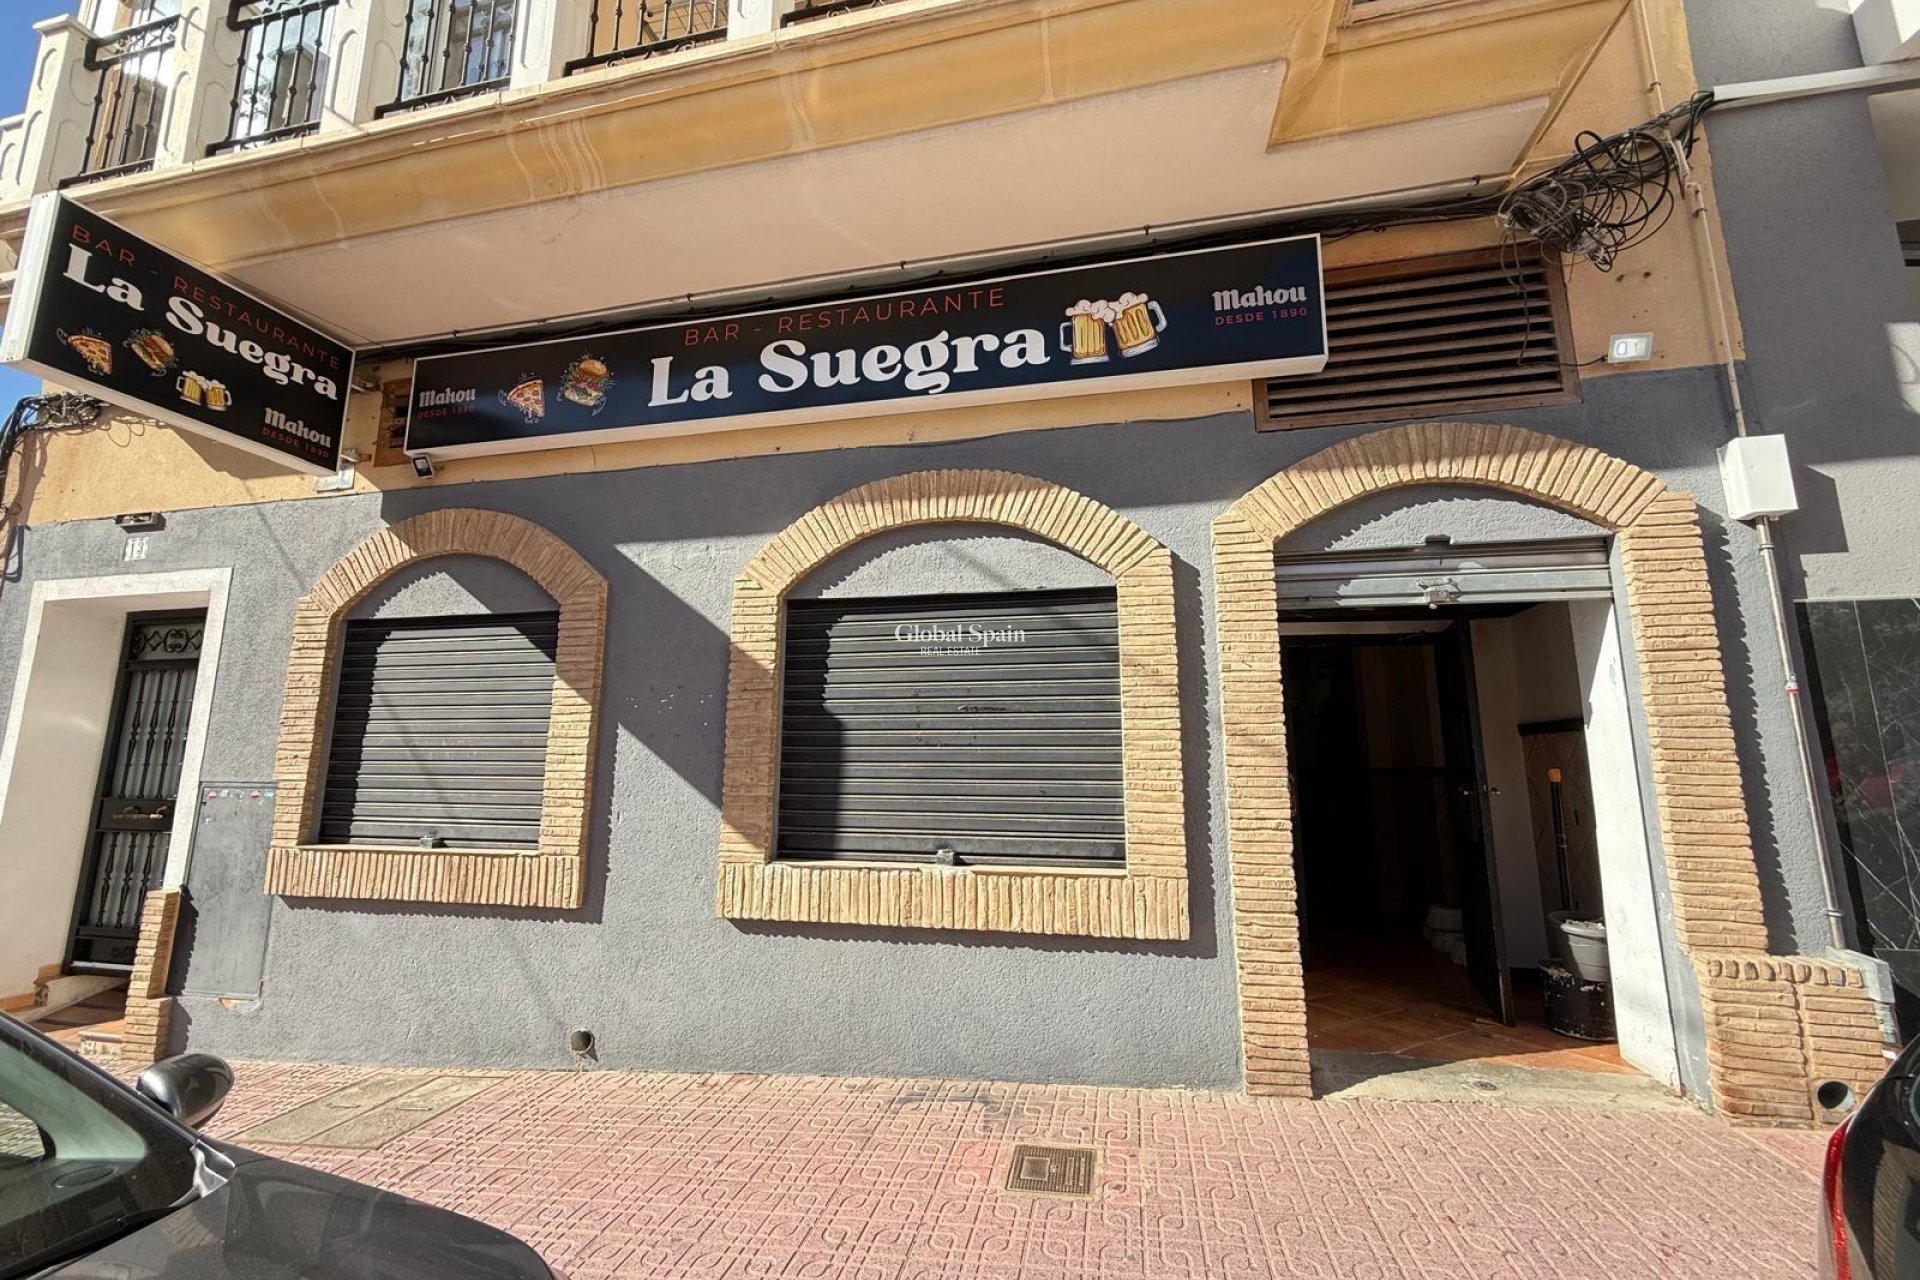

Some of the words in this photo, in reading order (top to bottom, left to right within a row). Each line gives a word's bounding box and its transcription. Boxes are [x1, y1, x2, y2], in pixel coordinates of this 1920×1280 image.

[72, 224, 135, 267] BAR
[173, 275, 340, 370] RESTAURANTE
[684, 322, 740, 347] BAR
[778, 287, 1005, 334] RESTAURANTE
[1212, 285, 1307, 311] Mahou
[1215, 311, 1265, 325] DESDE
[1272, 307, 1308, 319] 1890
[63, 243, 144, 311] La
[165, 296, 338, 401] Suegra
[647, 355, 733, 407] La
[758, 327, 1051, 395] Suegra
[419, 387, 476, 407] Mahou
[262, 427, 300, 447] DESDE
[264, 407, 331, 448] Mahou
